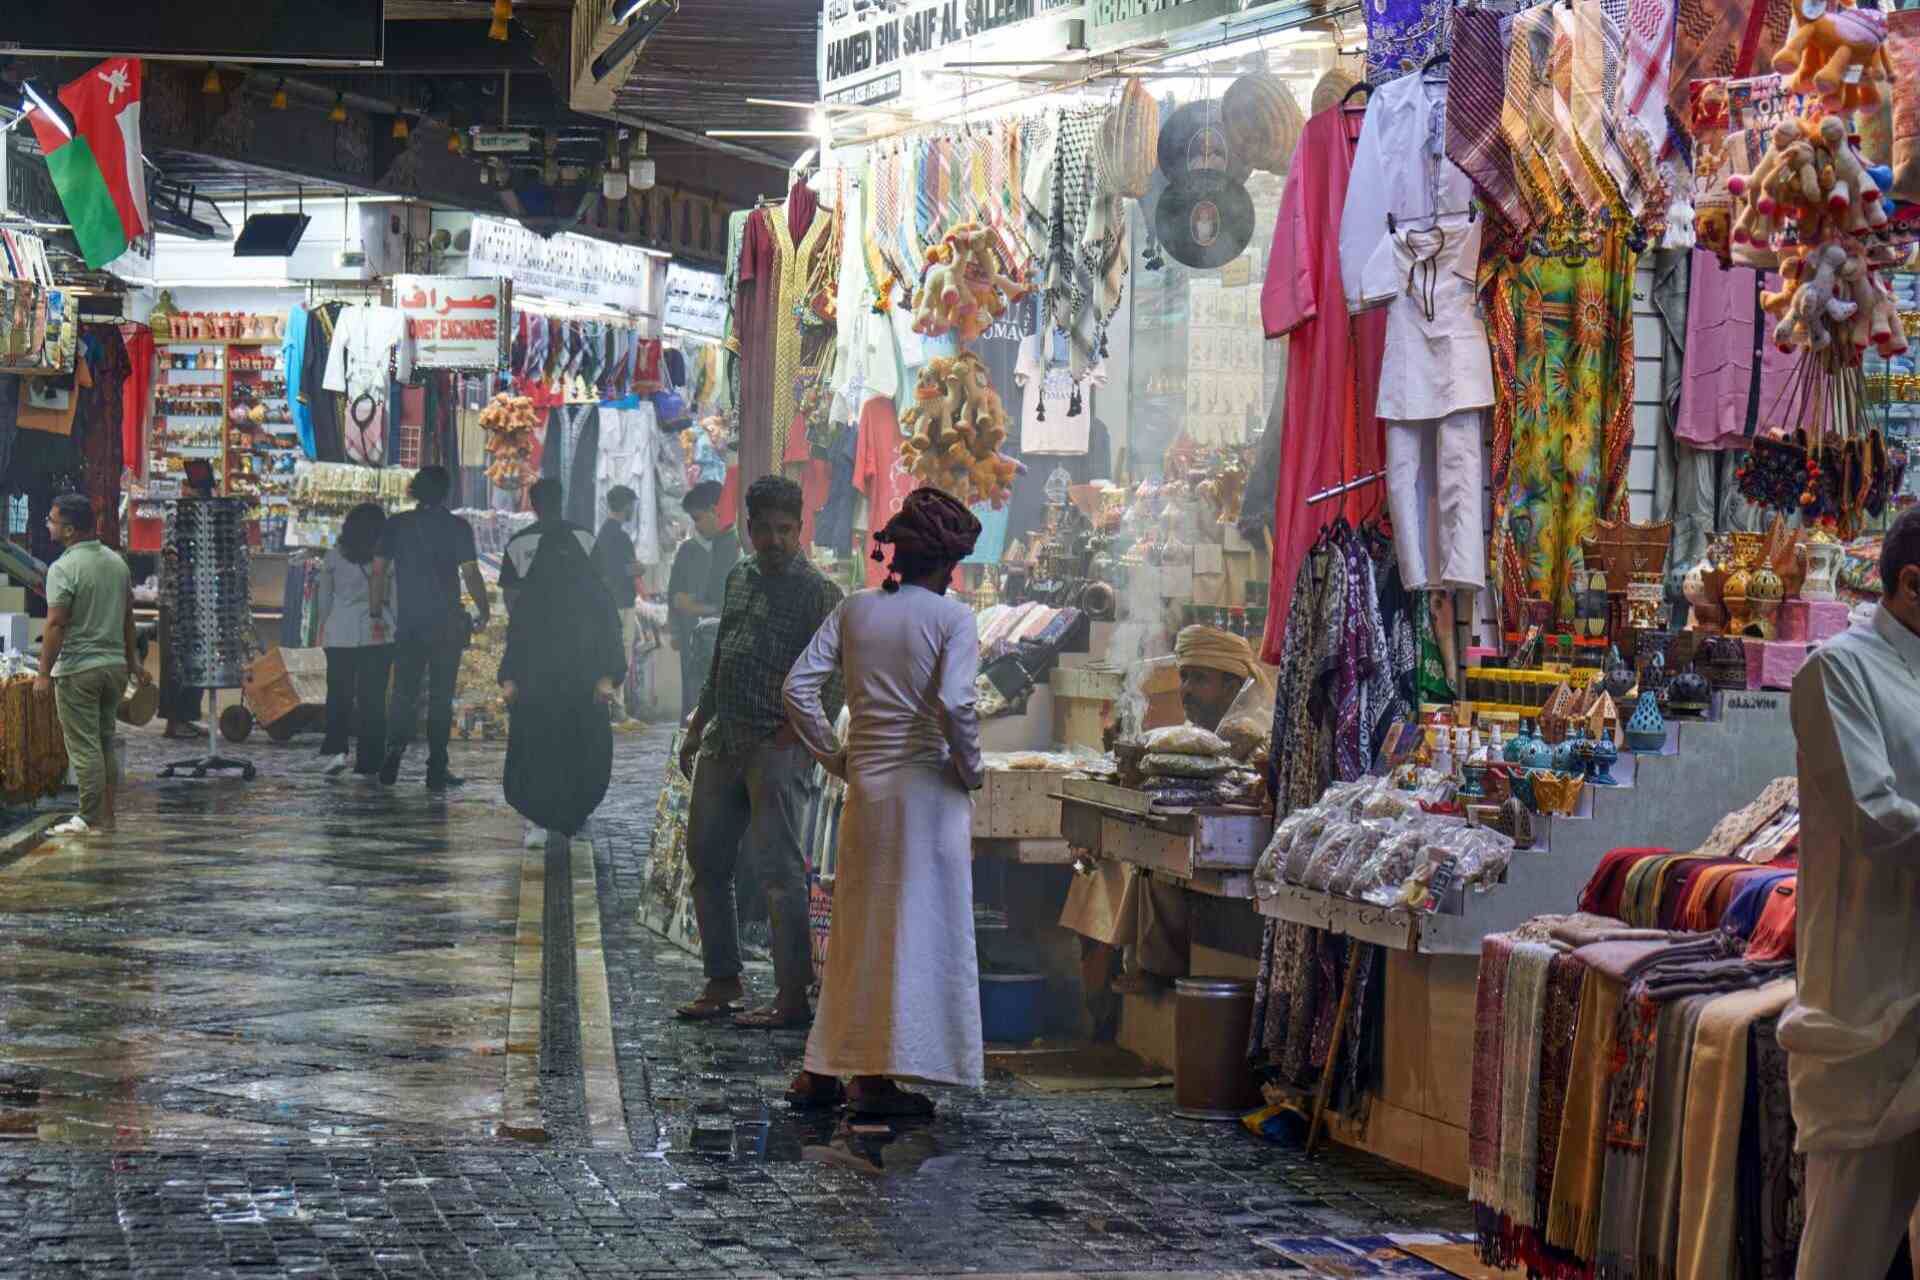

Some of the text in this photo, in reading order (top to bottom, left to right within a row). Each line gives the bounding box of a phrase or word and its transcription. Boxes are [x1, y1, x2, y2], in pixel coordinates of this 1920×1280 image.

[826, 30, 872, 81] HAMED
[876, 18, 899, 65] BIN
[903, 7, 937, 56] SAIF
[940, 0, 961, 46] AL
[409, 319, 497, 339] ONEY EXCHANGE
